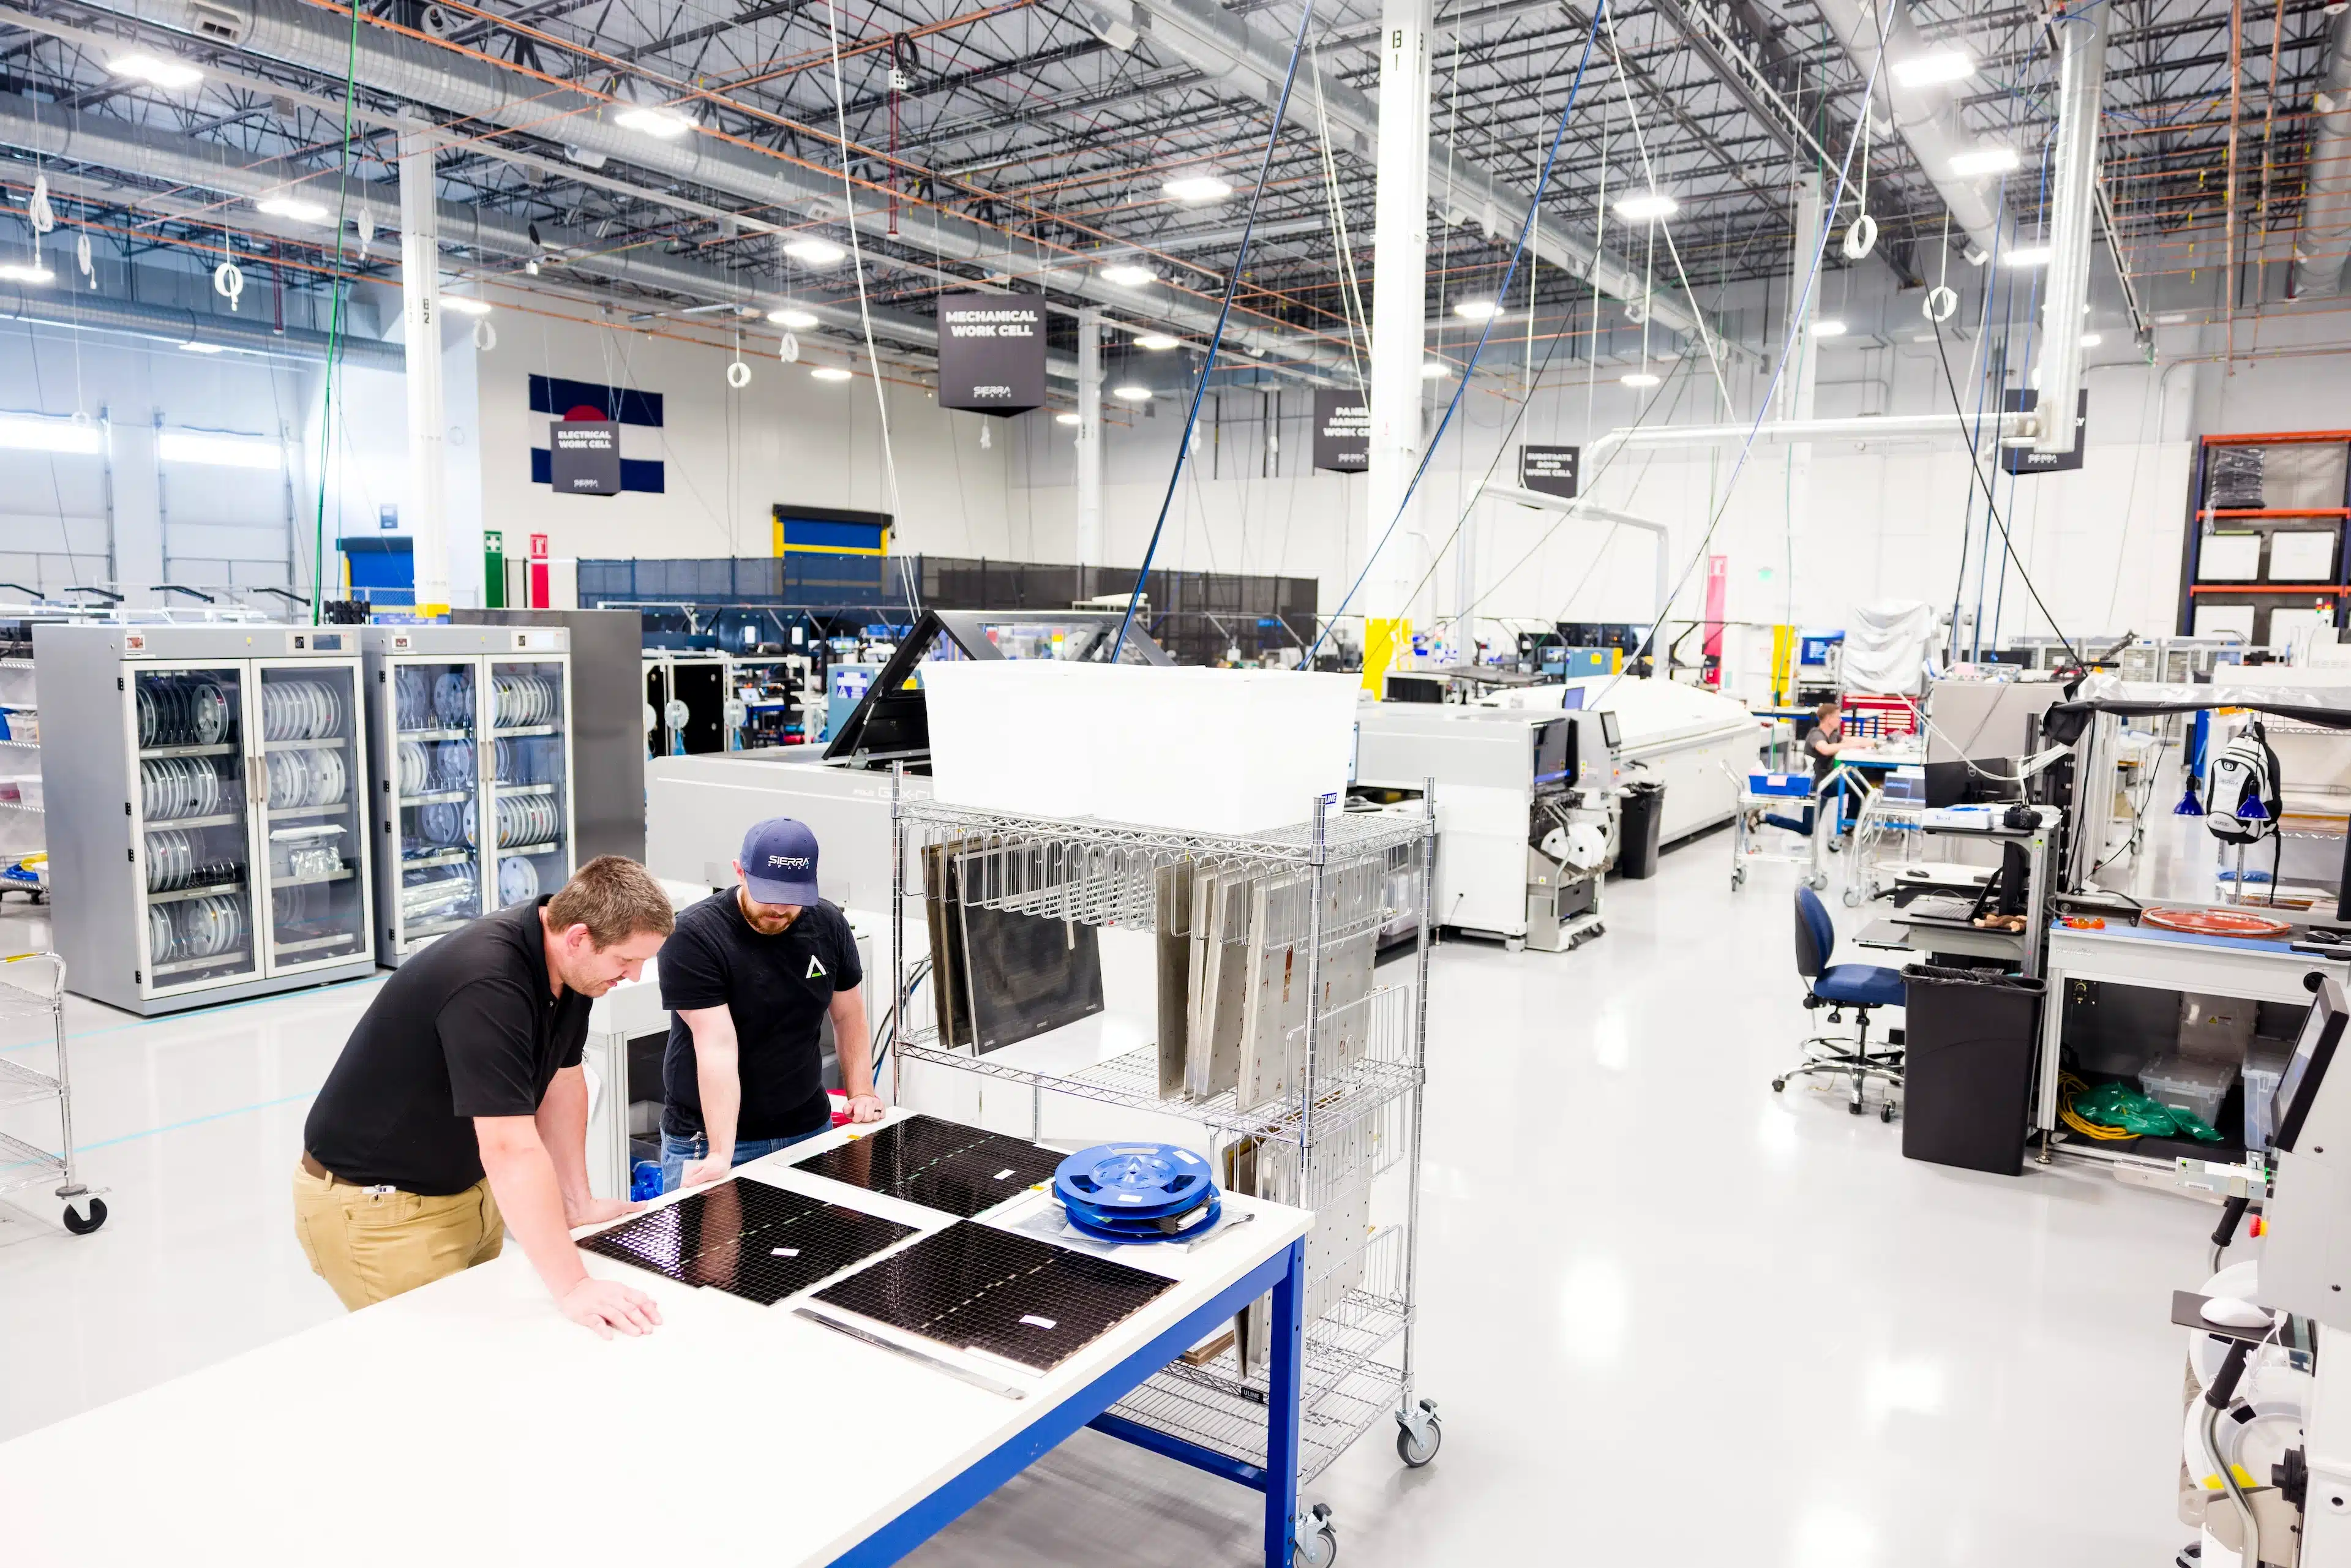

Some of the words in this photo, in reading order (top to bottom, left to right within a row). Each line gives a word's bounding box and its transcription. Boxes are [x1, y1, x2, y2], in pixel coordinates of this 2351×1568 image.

[945, 310, 1038, 322] MECHANICAL
[951, 325, 996, 337] WORK
[999, 324, 1033, 336] CELL
[558, 430, 612, 439] ELECTRICAL
[1323, 427, 1357, 437] WORK
[558, 440, 588, 449] WORK
[588, 440, 612, 449] CELL
[768, 855, 809, 867] SIERRA
[1244, 1390, 1259, 1400] ULINE
